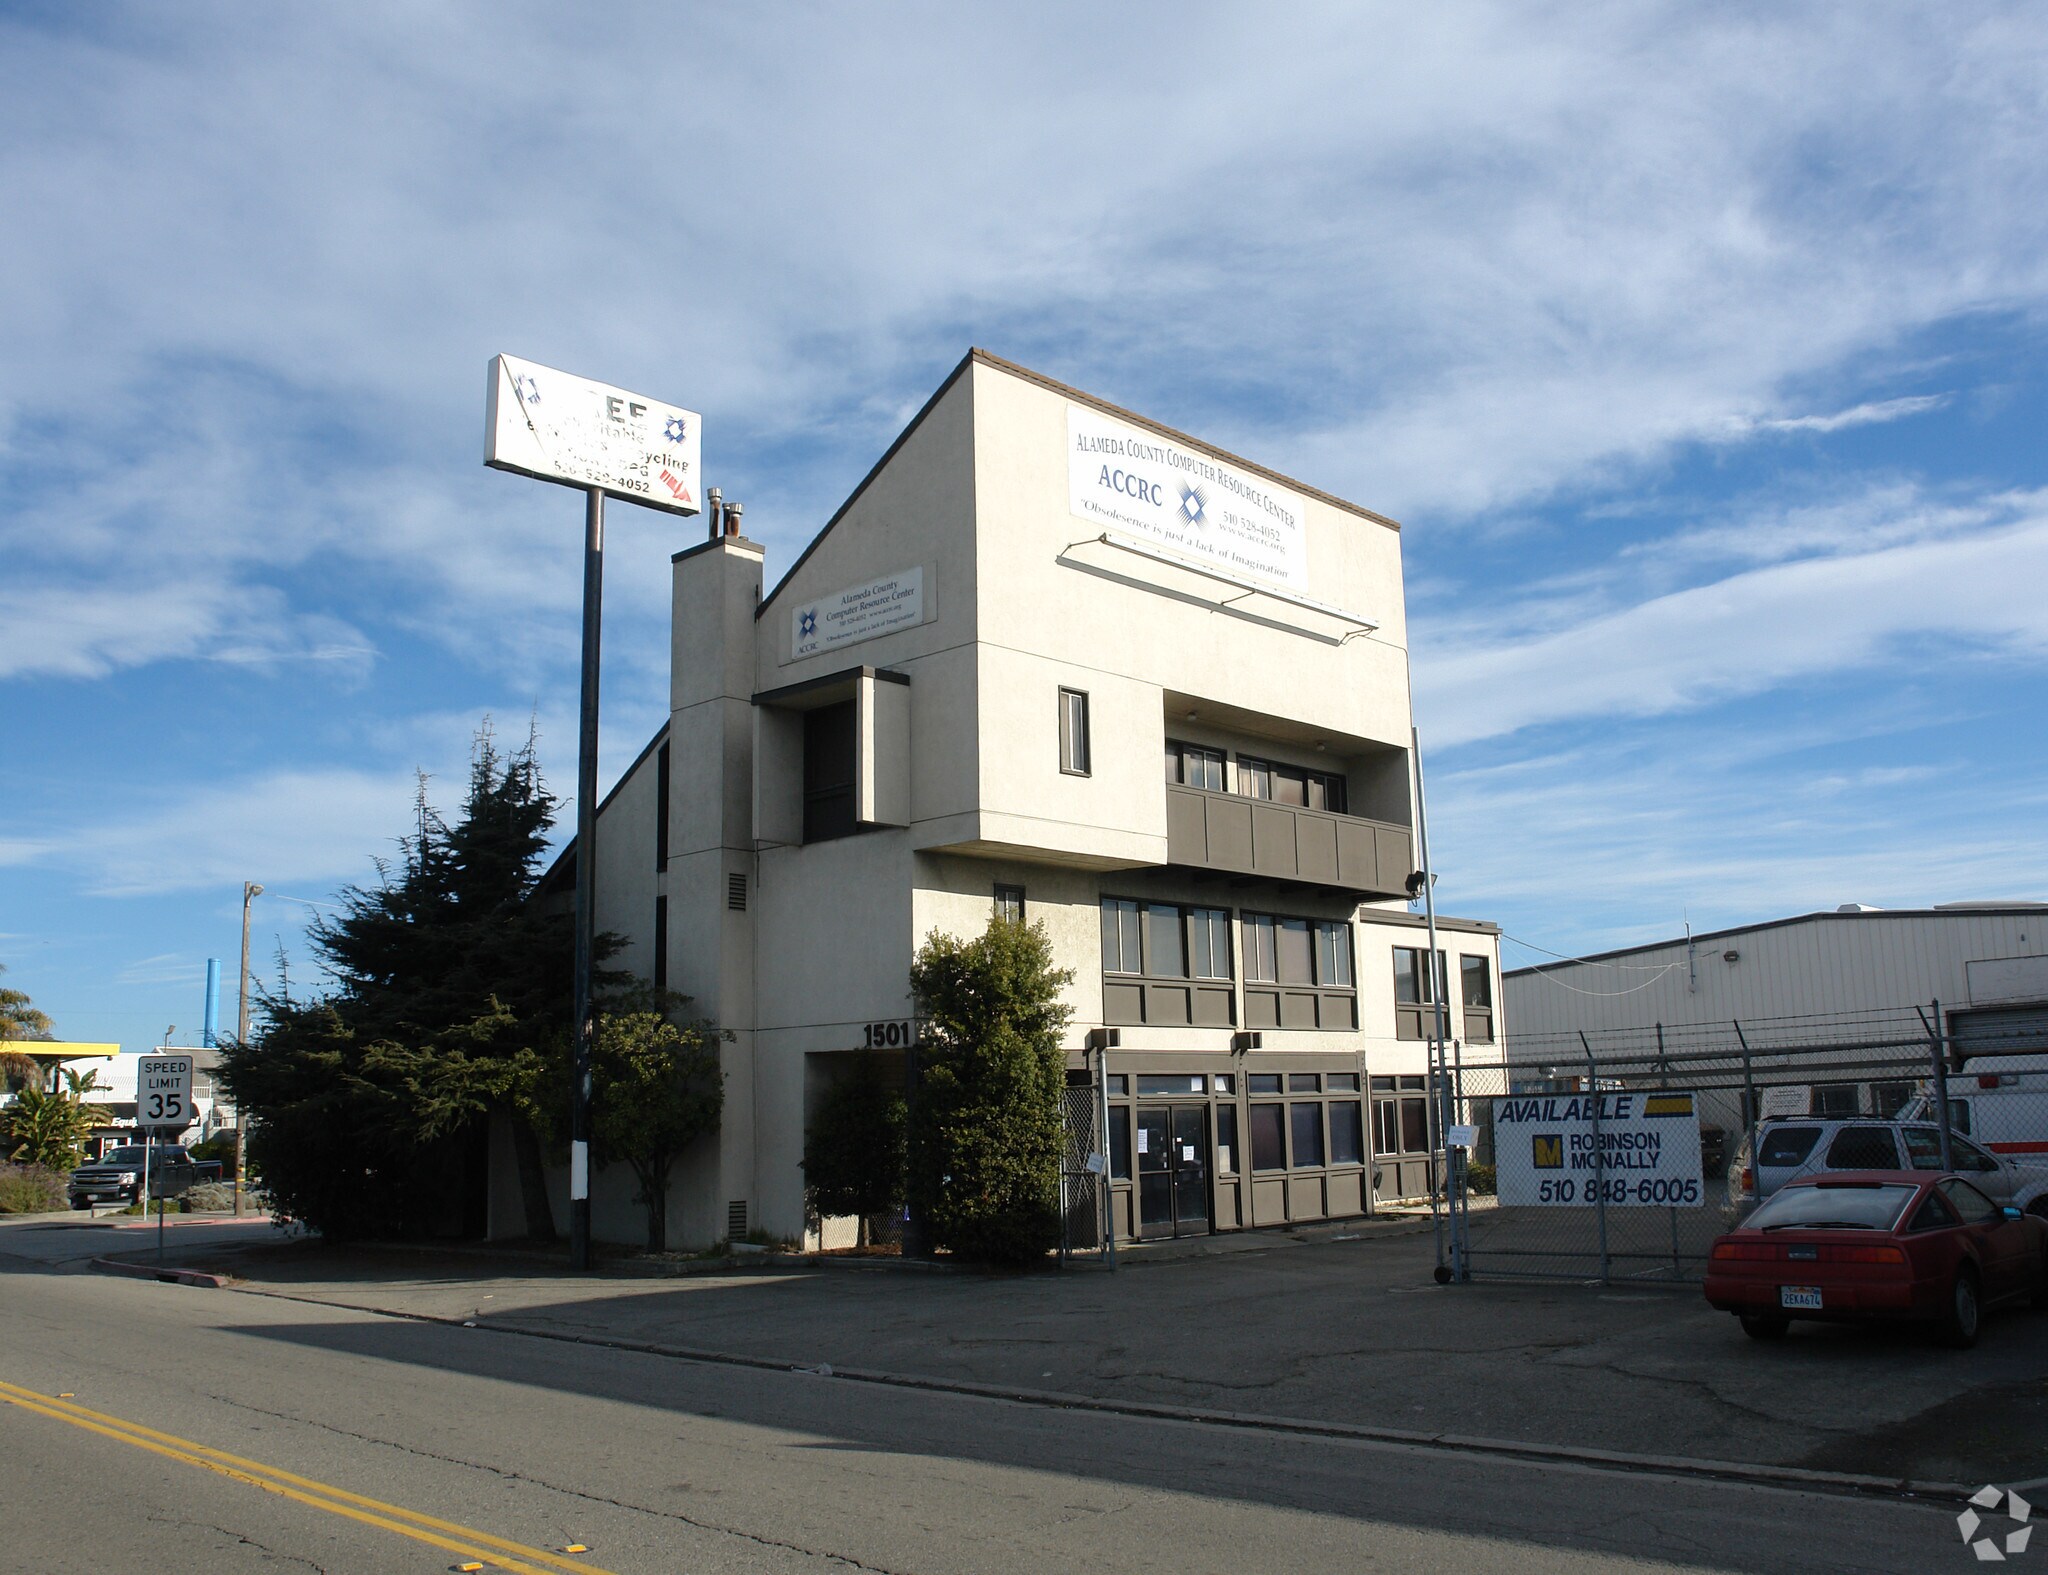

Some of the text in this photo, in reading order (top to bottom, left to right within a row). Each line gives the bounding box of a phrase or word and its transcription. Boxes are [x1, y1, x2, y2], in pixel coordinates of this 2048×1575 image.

[1076, 433, 1296, 530] ALAMEDA COUNTY COMPUTER RESOURCE CENTER
[1098, 464, 1163, 507] ACCRC
[1218, 523, 1286, 556] www.accrc.org
[1223, 511, 1281, 542] 510 528-4052
[1153, 523, 1162, 535] is
[1164, 527, 1185, 544] just
[1195, 539, 1214, 554] lack
[1218, 549, 1230, 558] of
[826, 588, 915, 621] Computer Resource Center
[840, 580, 898, 606] Alameda County
[798, 641, 819, 654] ACCRC
[864, 1022, 909, 1048] 1501
[145, 1062, 187, 1073] SPEED
[148, 1078, 181, 1089] LIMIT
[147, 1093, 182, 1119] 35
[1498, 1096, 1633, 1123] AVAILABLE
[1570, 1132, 1661, 1151] ROBINSON
[1539, 1178, 1699, 1203] 510 848-6005
[1784, 1293, 1820, 1305] 2EKA674
